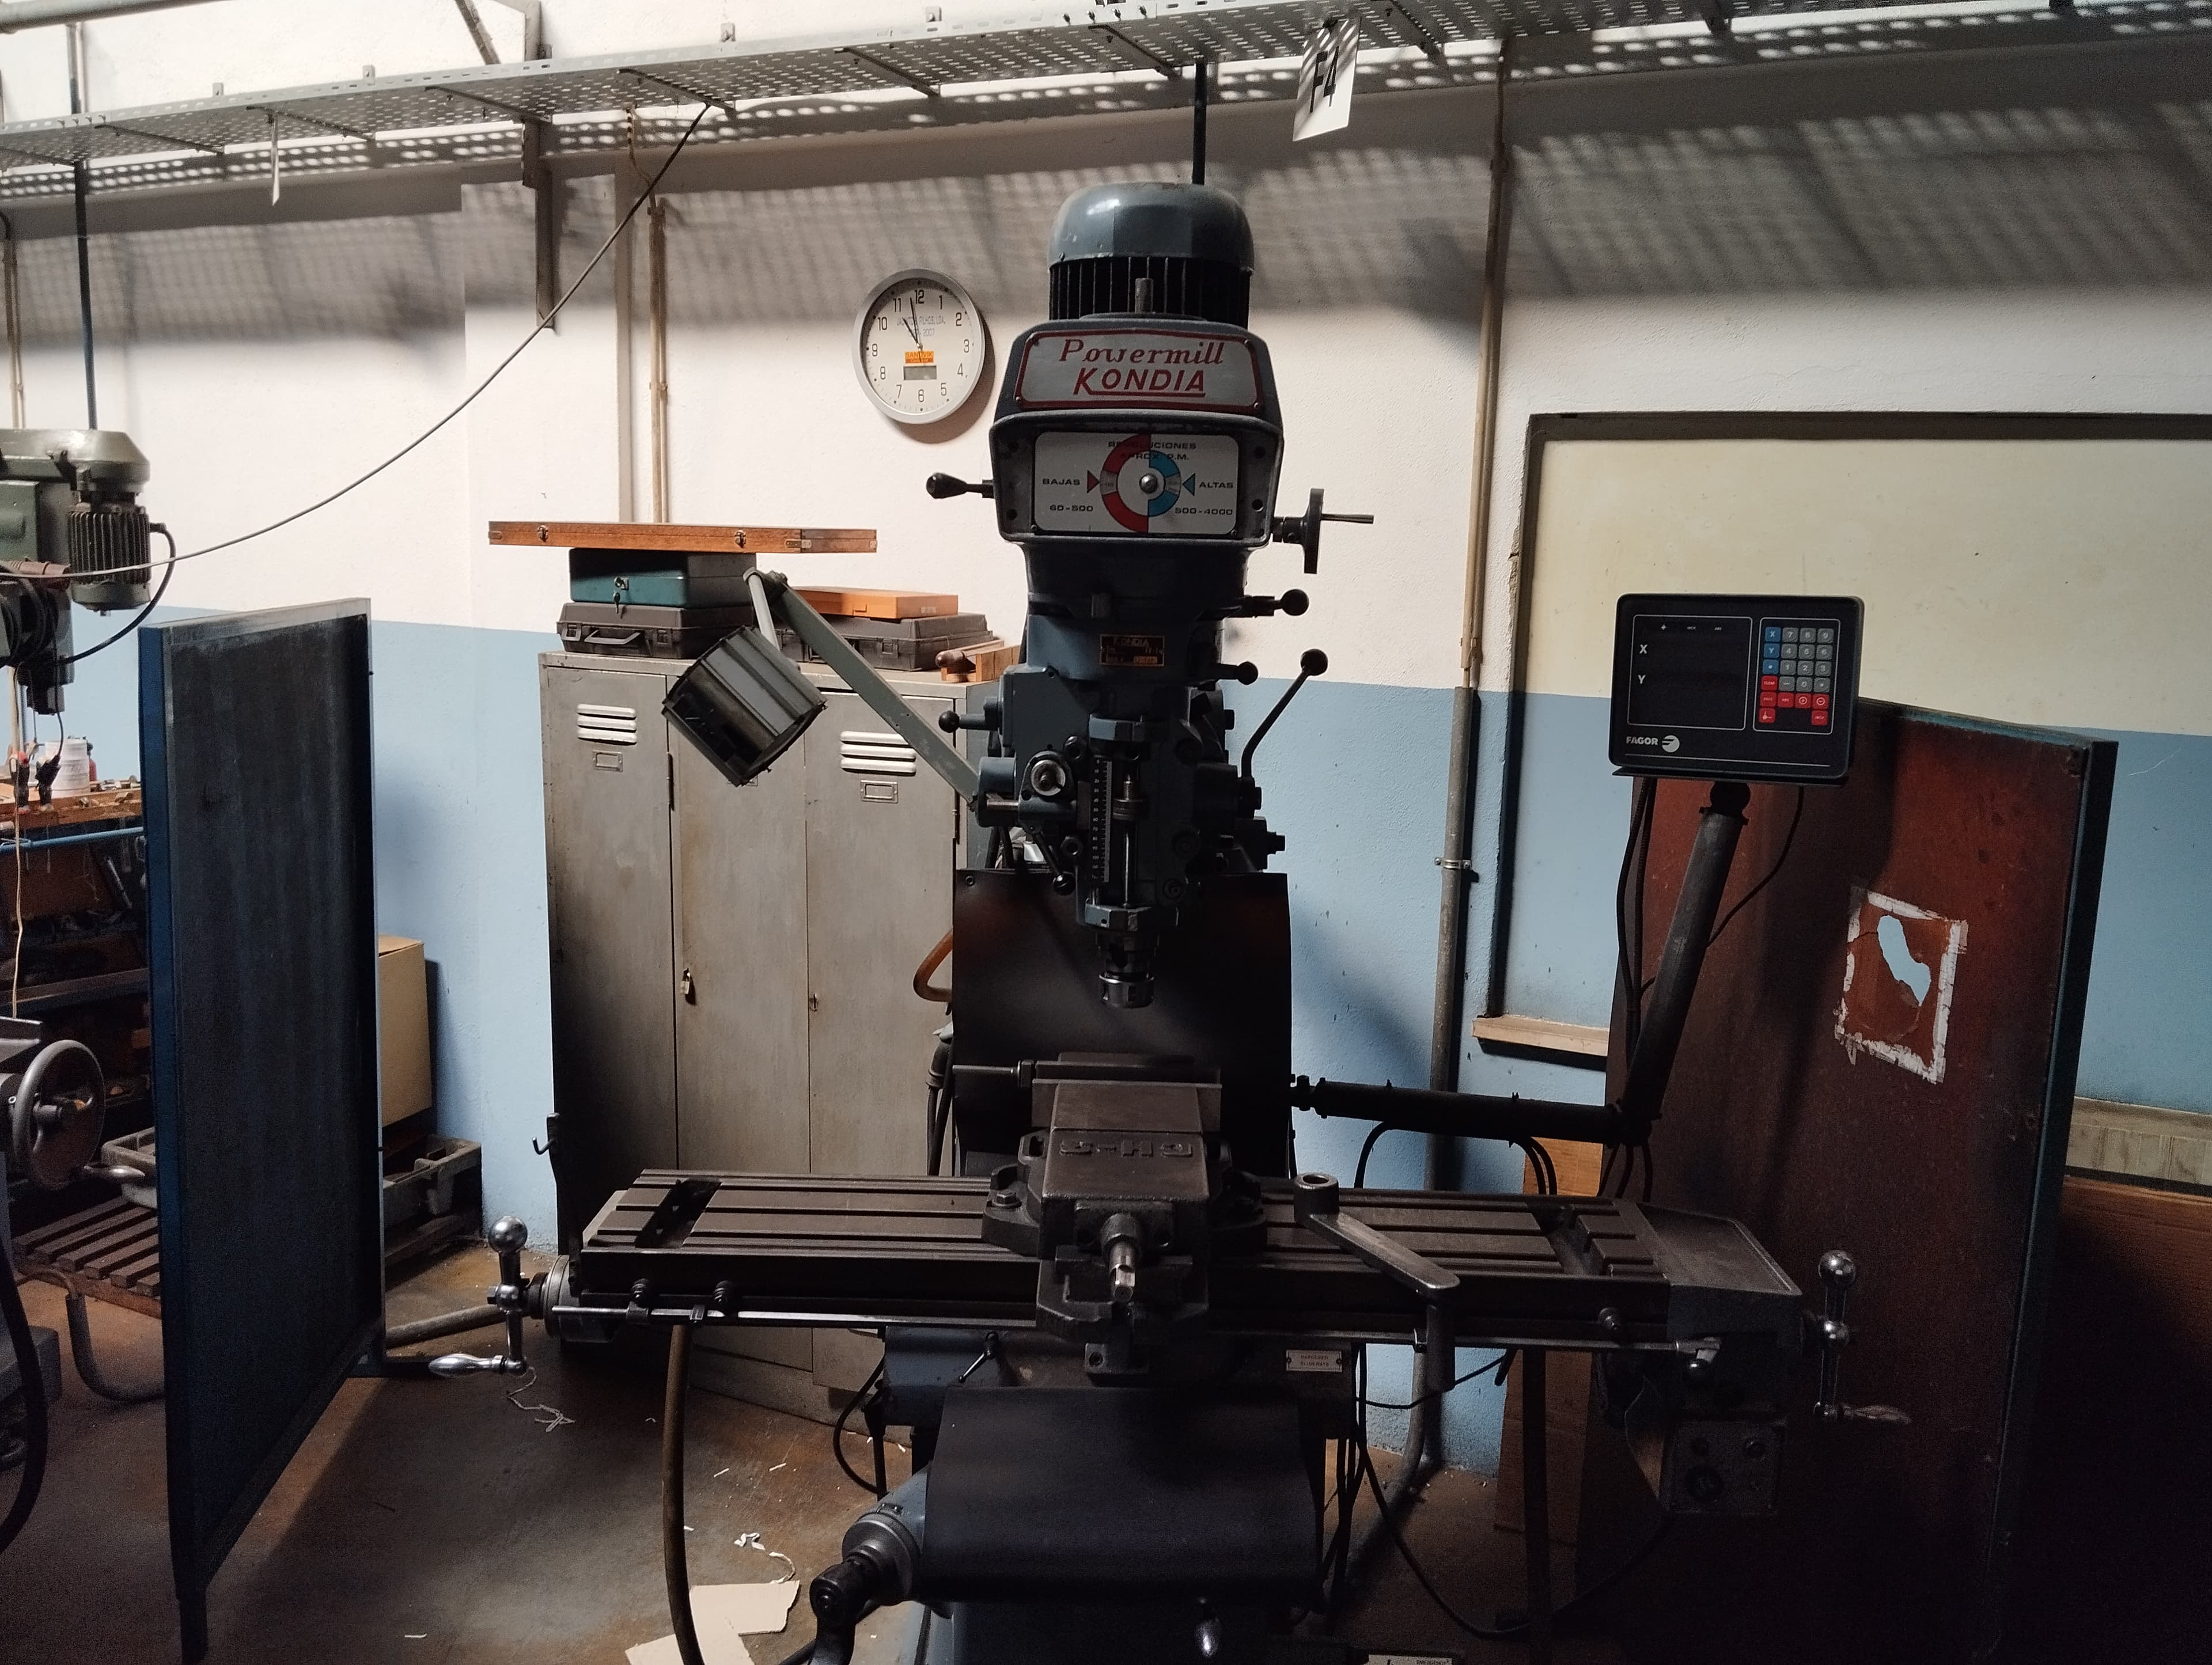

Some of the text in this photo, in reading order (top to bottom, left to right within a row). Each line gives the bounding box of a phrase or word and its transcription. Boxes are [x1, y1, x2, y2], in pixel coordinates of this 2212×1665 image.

[1309, 46, 1339, 113] F4
[914, 289, 925, 304] 12
[939, 295, 942, 309] 1
[893, 298, 902, 312] 11
[878, 317, 888, 331] 10
[955, 312, 962, 327] 2
[923, 328, 935, 336] 2007
[872, 344, 878, 356] 9
[963, 339, 970, 353] 3
[1059, 339, 1225, 365] Powermill
[880, 366, 886, 380] 8
[957, 363, 964, 377] 4
[940, 382, 947, 396] 5
[1074, 367, 1206, 397] KONDIA
[896, 384, 902, 399] 7
[918, 389, 925, 403] 6
[1639, 644, 1647, 654] X
[1638, 674, 1646, 684] Y
[1626, 736, 1658, 746] FAGOR
